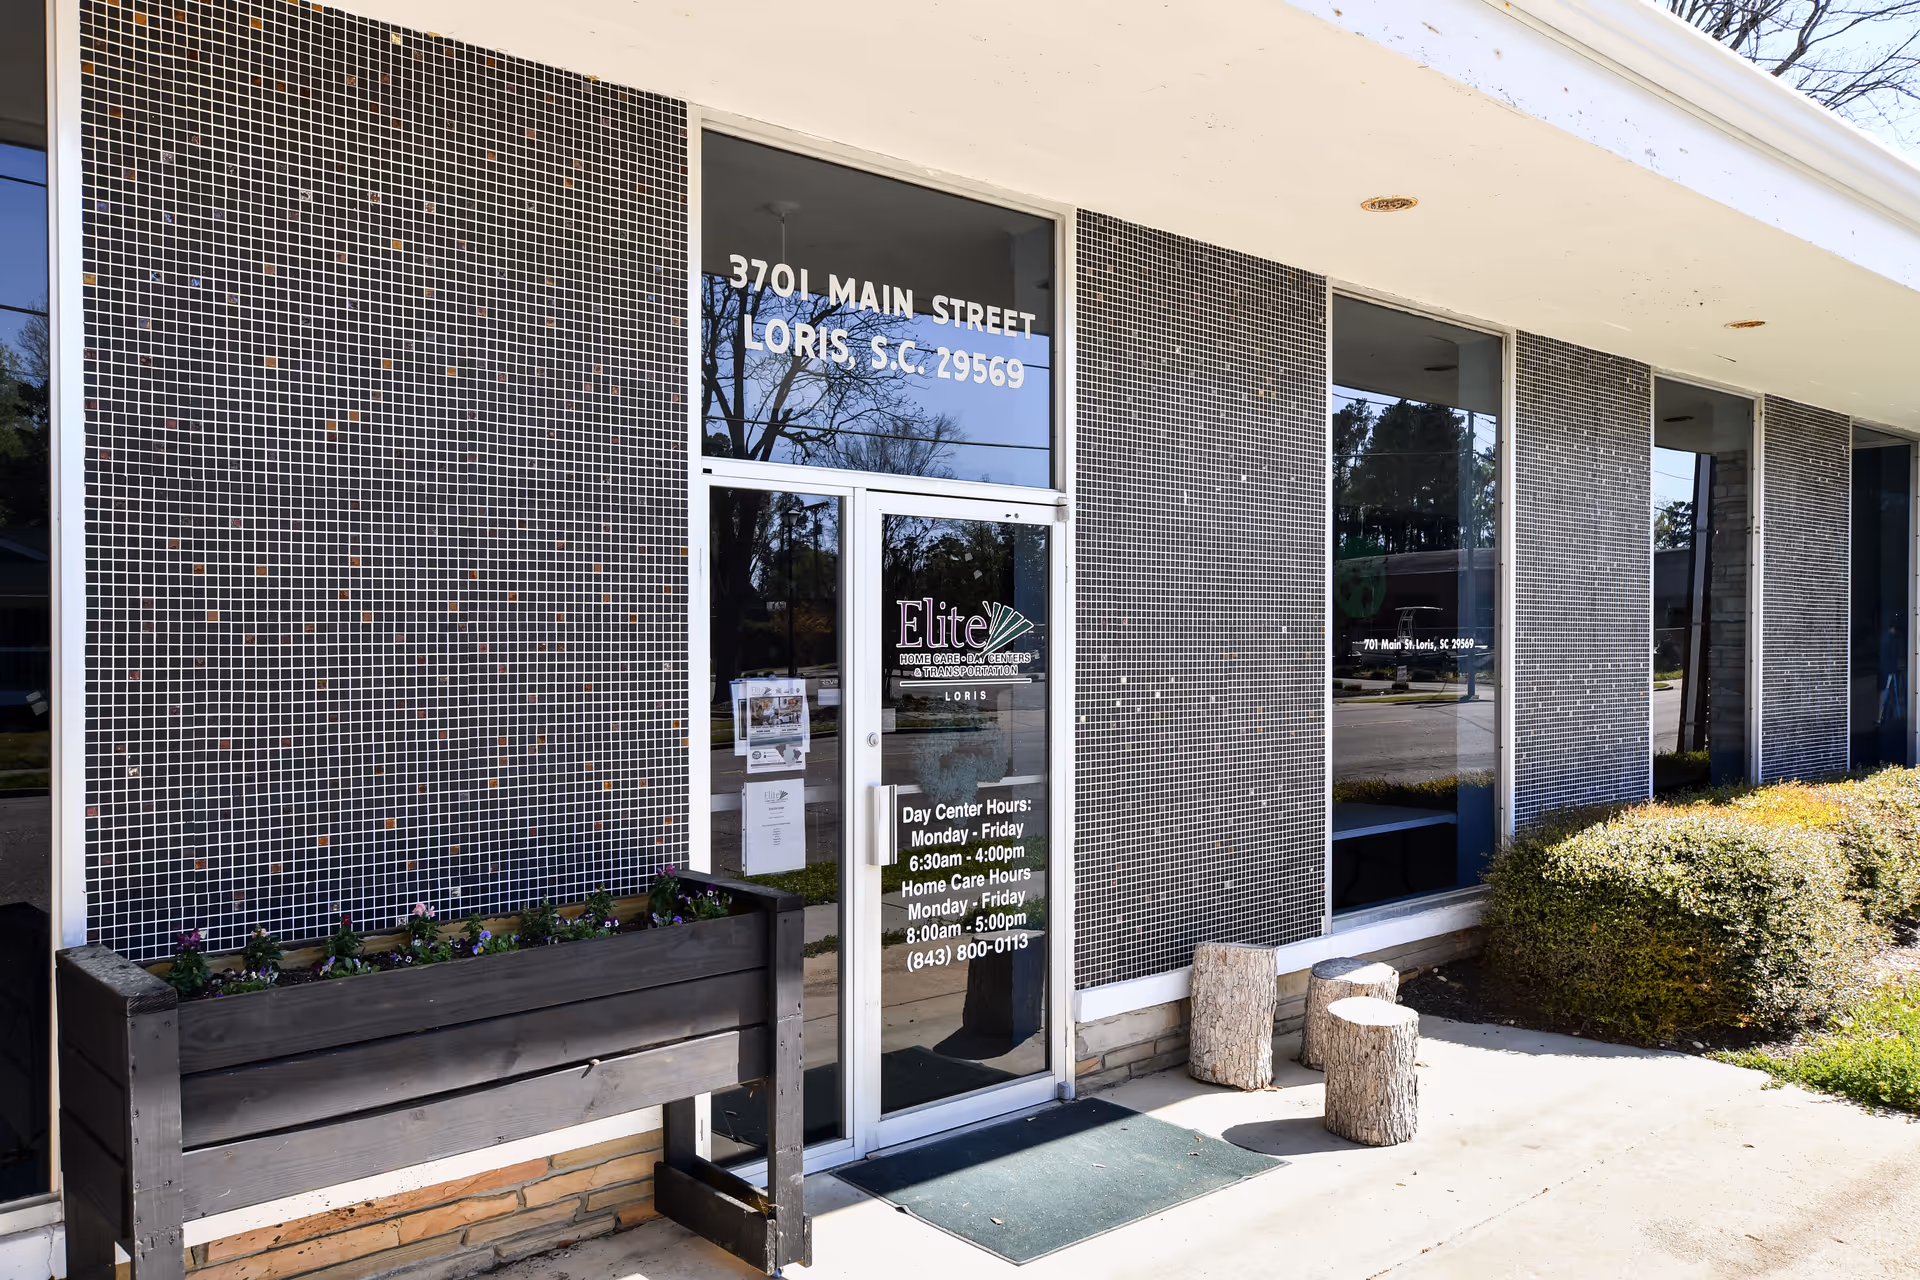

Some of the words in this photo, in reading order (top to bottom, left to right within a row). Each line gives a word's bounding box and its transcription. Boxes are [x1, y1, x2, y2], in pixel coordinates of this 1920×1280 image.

[729, 254, 808, 300] 3701
[829, 273, 913, 319] MAIN
[932, 294, 1036, 340] STREET
[744, 314, 856, 371] LORIS,
[871, 336, 925, 375] S.C.
[937, 346, 1025, 389] 29569
[896, 597, 988, 649] Elite
[900, 653, 931, 665] HOME
[933, 653, 960, 664] CARE
[966, 653, 986, 664] DAY
[987, 652, 1032, 664] CENTERS
[1363, 638, 1378, 650] 701
[1381, 638, 1402, 650] Main
[1439, 638, 1449, 650] SC
[1451, 638, 1474, 649] 29569
[914, 667, 922, 677] &
[923, 665, 1019, 677] TRANSPORTATION
[945, 691, 986, 701] LORIS
[902, 807, 931, 825] Day
[935, 801, 983, 820] Center
[986, 799, 1032, 815] Hours:
[911, 827, 969, 847] Monday
[981, 820, 1024, 839] Friday
[909, 853, 962, 872] 6:30am
[975, 844, 1025, 864] 4:00pm
[901, 879, 947, 898] Home
[950, 873, 985, 891] Care
[989, 867, 1031, 885] Hours
[908, 897, 968, 920] Monday
[981, 890, 1026, 909] Friday
[906, 922, 962, 944] 8:00am
[975, 912, 1027, 932] 5:00pm
[907, 945, 951, 972] (843)
[956, 932, 1029, 962] 800-0113
